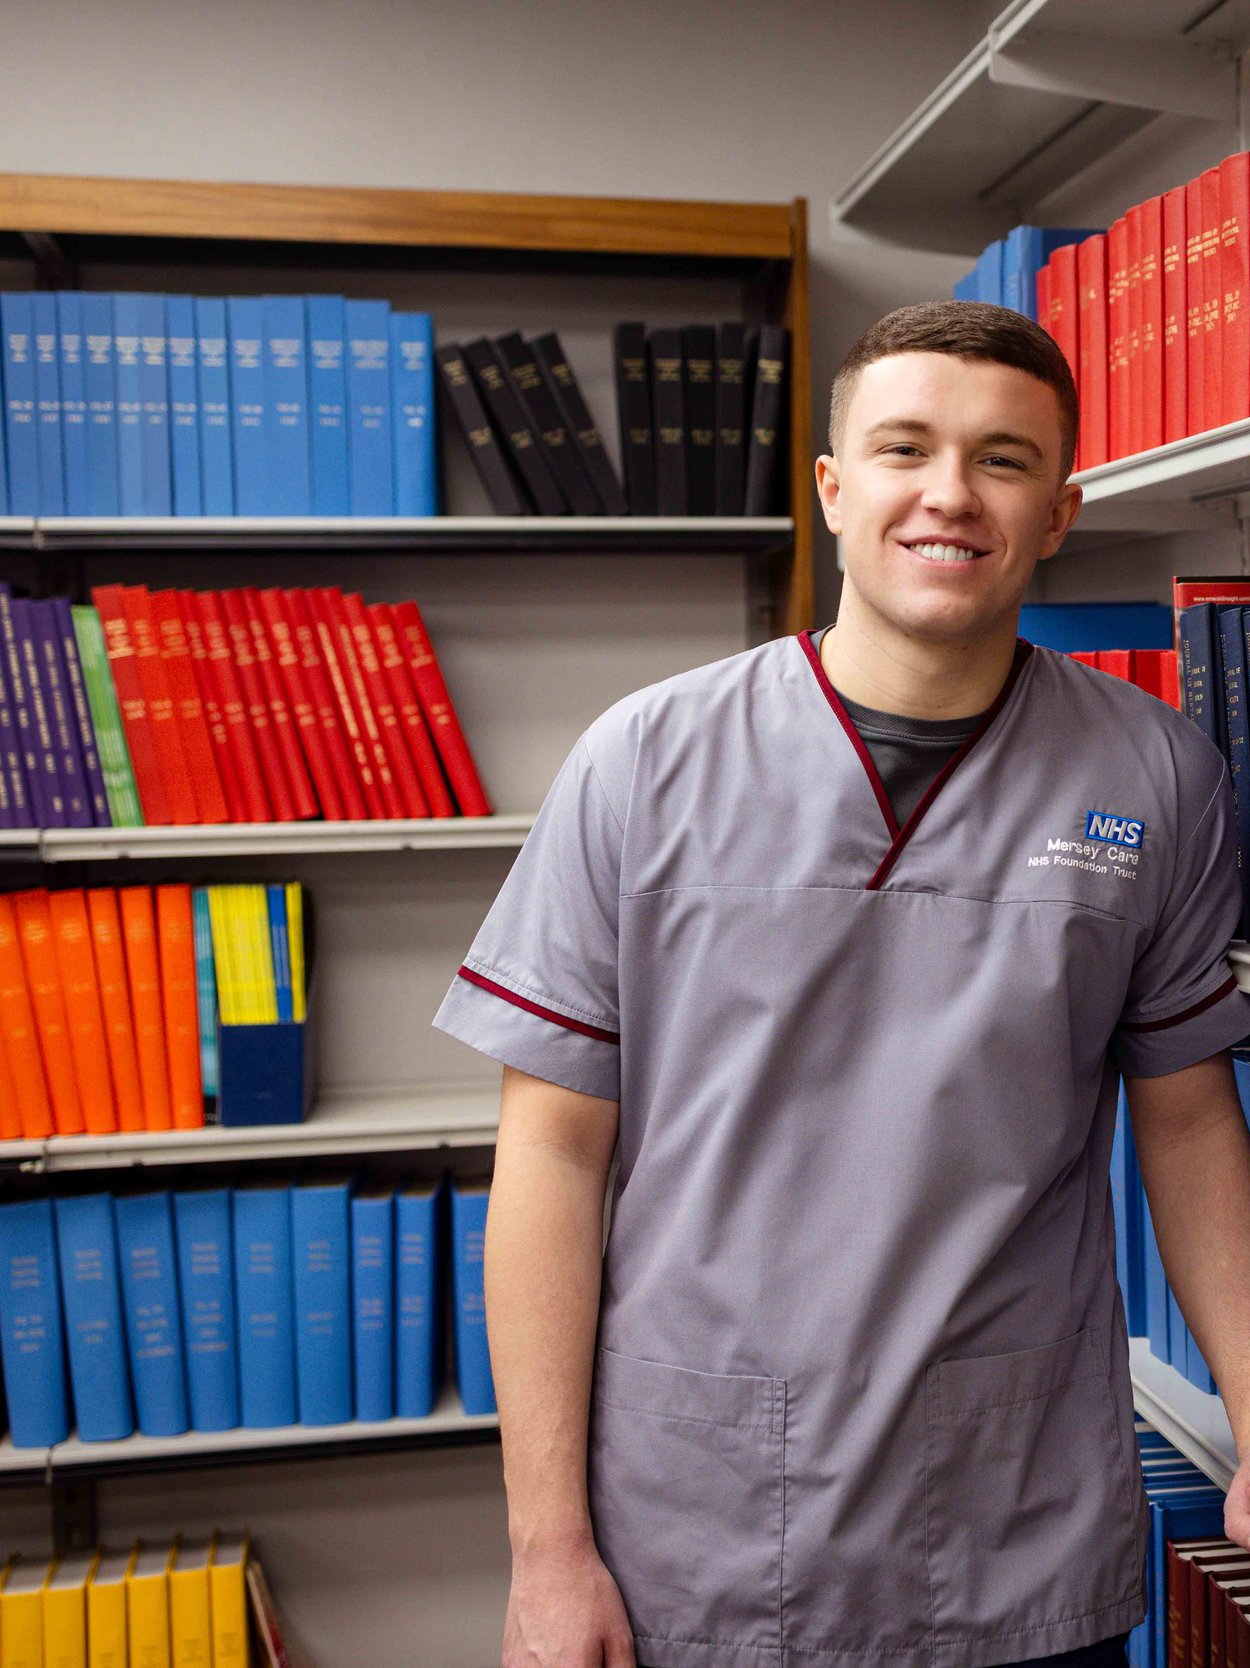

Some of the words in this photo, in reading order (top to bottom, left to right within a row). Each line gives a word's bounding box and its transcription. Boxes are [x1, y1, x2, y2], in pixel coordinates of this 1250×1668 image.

[1088, 814, 1141, 845] NHS
[1047, 838, 1100, 859] Mersey
[1107, 846, 1139, 865] Care
[1028, 856, 1049, 867] NHS
[1053, 855, 1107, 874] Foundation
[1112, 865, 1137, 880] Trust
